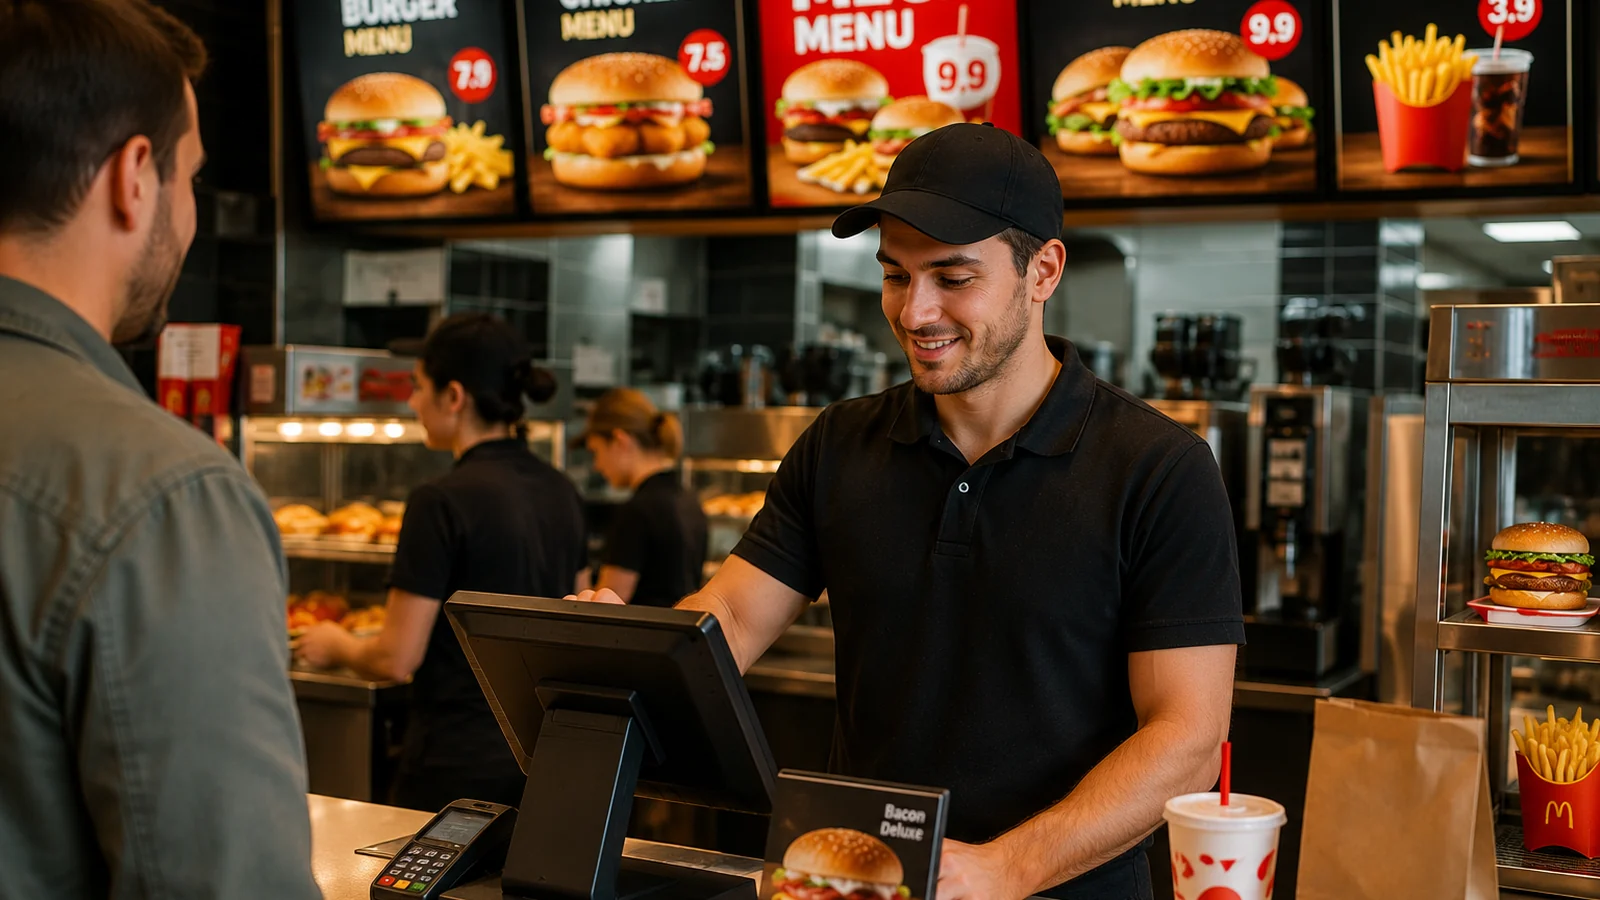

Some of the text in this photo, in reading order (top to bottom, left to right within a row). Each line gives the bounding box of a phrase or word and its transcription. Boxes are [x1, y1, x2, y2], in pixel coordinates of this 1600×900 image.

[560, 8, 635, 41] MENU
[1487, 0, 1535, 24] 3.9
[343, 24, 412, 57] MENU
[793, 8, 914, 55] MENU
[1249, 12, 1295, 45] 9.9
[684, 41, 726, 73] 7.5
[453, 59, 493, 90] 7.9
[938, 60, 986, 92] 9.9
[884, 803, 926, 824] Bacon
[880, 821, 924, 841] Deluxe
